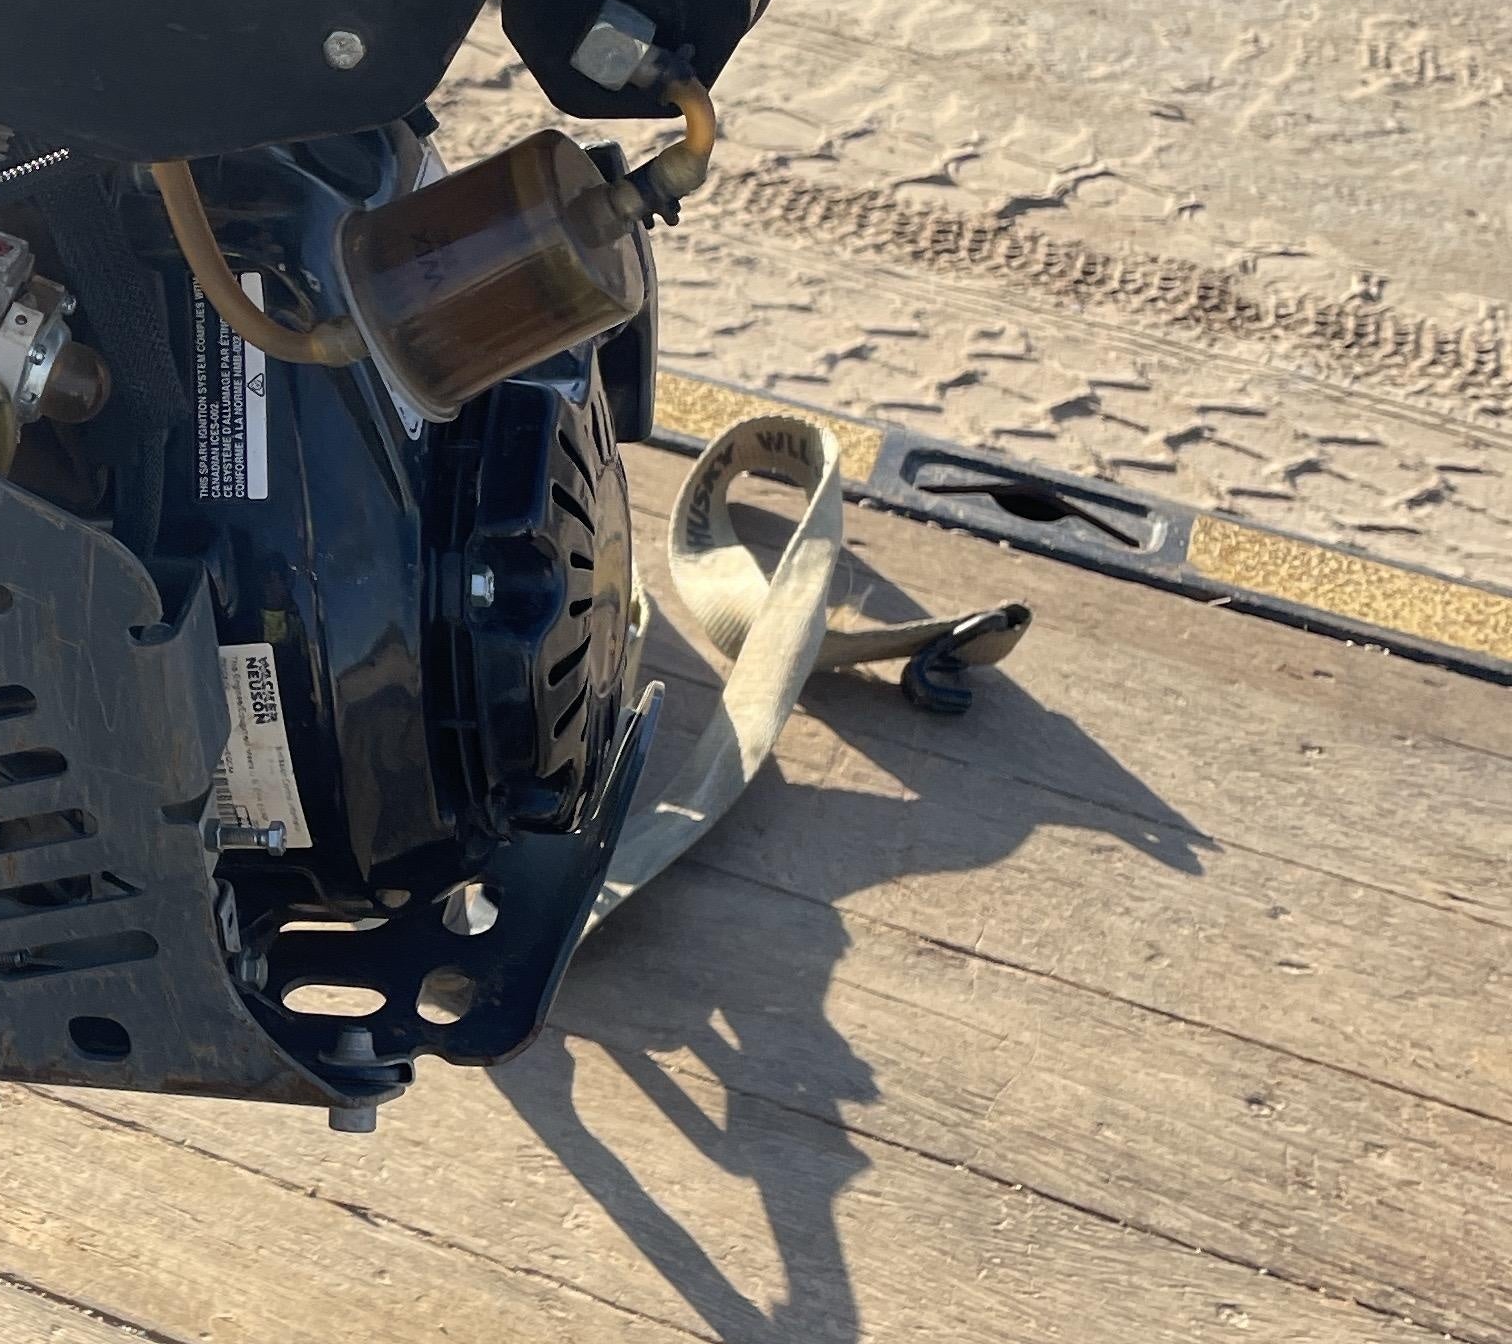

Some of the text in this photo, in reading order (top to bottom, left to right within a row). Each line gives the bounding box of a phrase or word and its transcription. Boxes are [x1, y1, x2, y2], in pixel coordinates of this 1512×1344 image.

[195, 302, 206, 352] COMPLIES
[197, 355, 207, 394] SYSTEM
[220, 348, 230, 368] PAR
[233, 380, 243, 415] NORME
[198, 396, 207, 438] IGNITION
[234, 417, 243, 430] LA
[199, 441, 208, 474] SPARK
[210, 448, 220, 498] CANADIAN
[235, 442, 244, 498] CONFORME
[200, 477, 208, 498] THIS
[223, 485, 232, 498] CE
[245, 656, 268, 725] NEUSON
